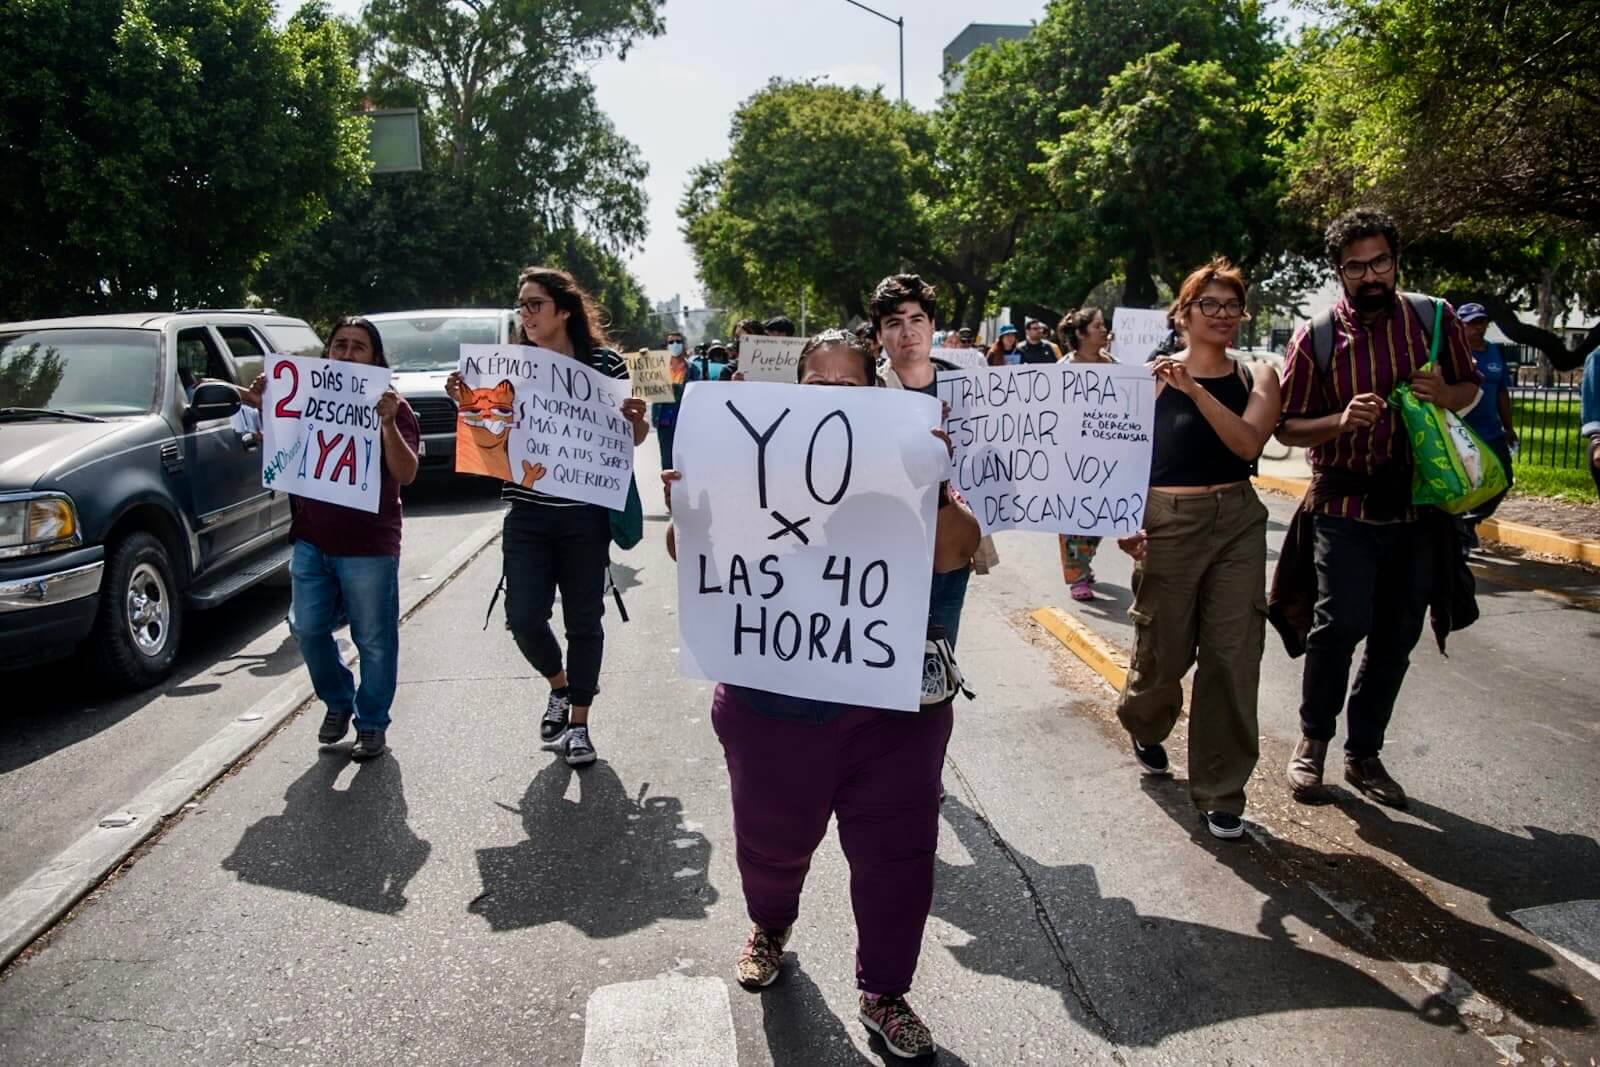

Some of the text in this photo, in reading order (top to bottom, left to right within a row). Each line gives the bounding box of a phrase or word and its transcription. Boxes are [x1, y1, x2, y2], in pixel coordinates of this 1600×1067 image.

[624, 356, 666, 370] USTICIA
[752, 349, 798, 366] Pueblo
[273, 360, 368, 419] 2 DÍAS DE
[551, 363, 592, 402] NO
[597, 387, 616, 408] ES
[937, 370, 1050, 408] TRABAJO
[1062, 370, 1117, 405] PARA
[304, 397, 380, 431] DESCANSO
[533, 394, 632, 439] NORMAL VER
[947, 410, 1058, 447] ESTUDIAR
[1082, 420, 1142, 431] EL DERECHO
[530, 415, 627, 454] MÁS A TU JEFE
[1092, 429, 1149, 442] DESCANSAR
[526, 438, 630, 471] QUE A TUS SERES
[726, 400, 853, 509] YO
[1065, 452, 1118, 489] VOY
[553, 463, 621, 491] QUERIDOS
[985, 493, 1143, 533] DESCANSAR?
[699, 554, 889, 608] LAS 40
[734, 603, 896, 668] HORAS
